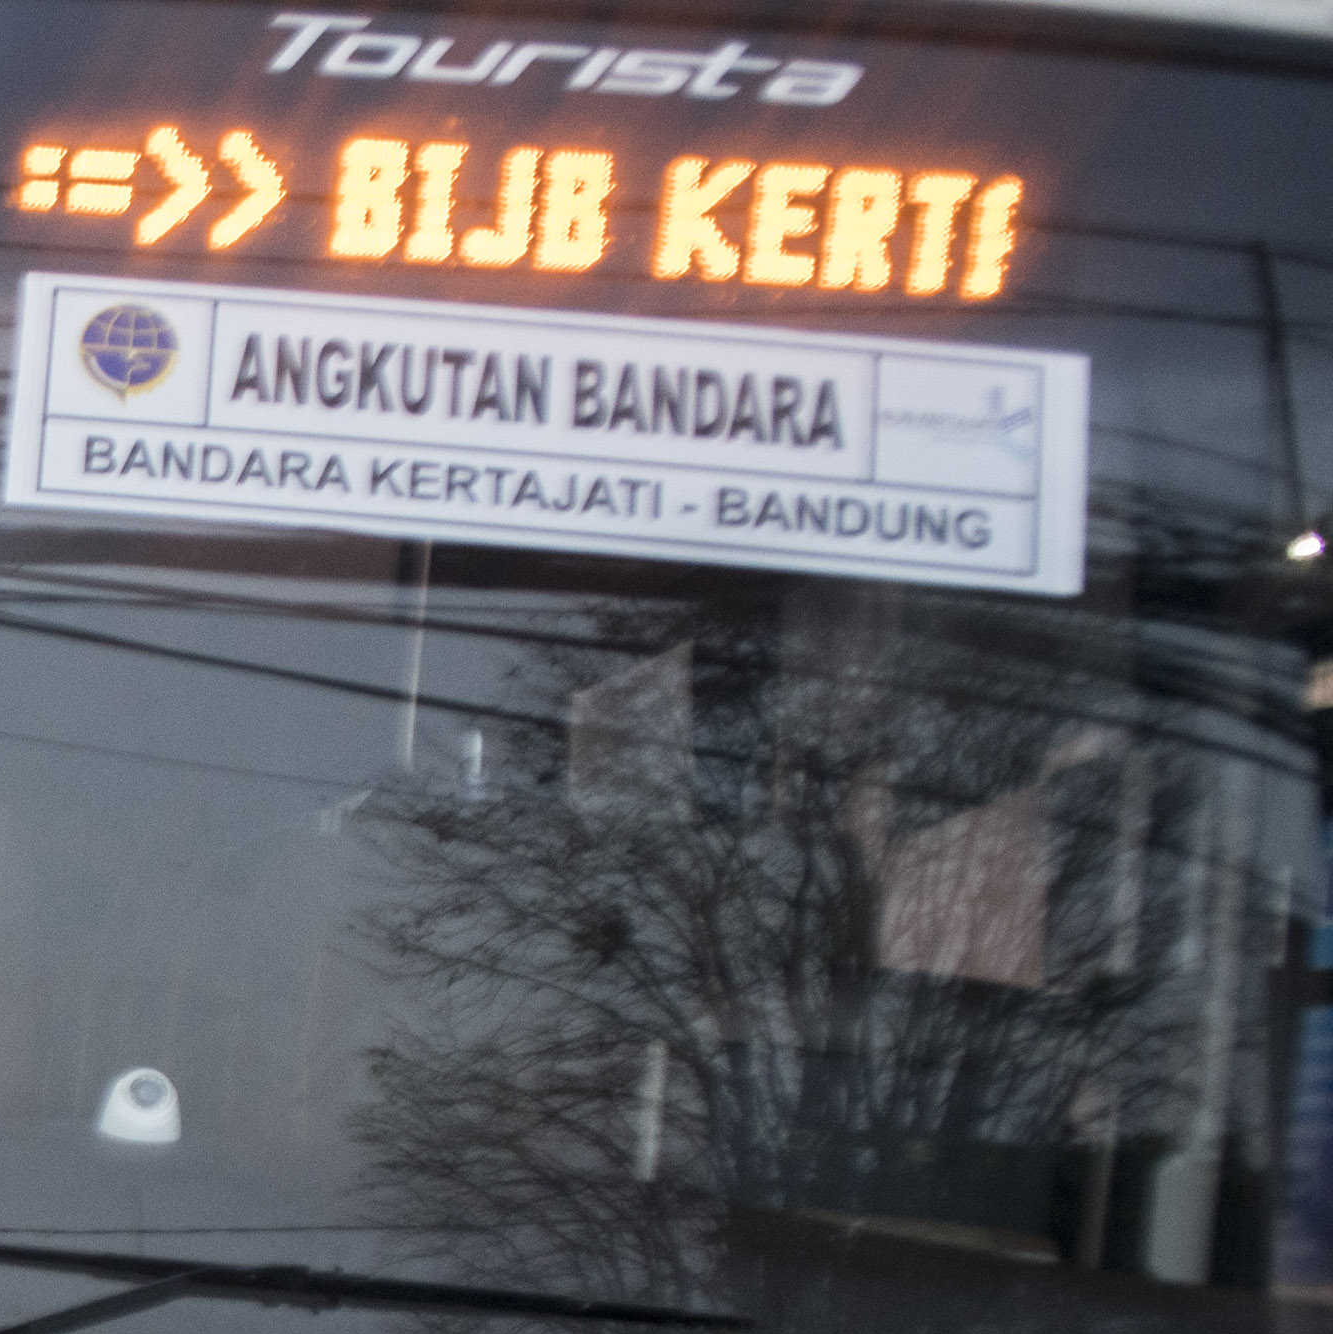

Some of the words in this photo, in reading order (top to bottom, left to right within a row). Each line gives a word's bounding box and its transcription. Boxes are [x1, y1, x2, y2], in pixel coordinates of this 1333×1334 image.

[265, 11, 864, 106] Tourista
[333, 138, 615, 272] BIJB
[230, 331, 549, 428] ANGKUTAN
[574, 361, 845, 451] BANDARA
[83, 434, 345, 495] BANDARA
[369, 456, 662, 522] KERTAJATI
[716, 487, 992, 550] BANDUNG
